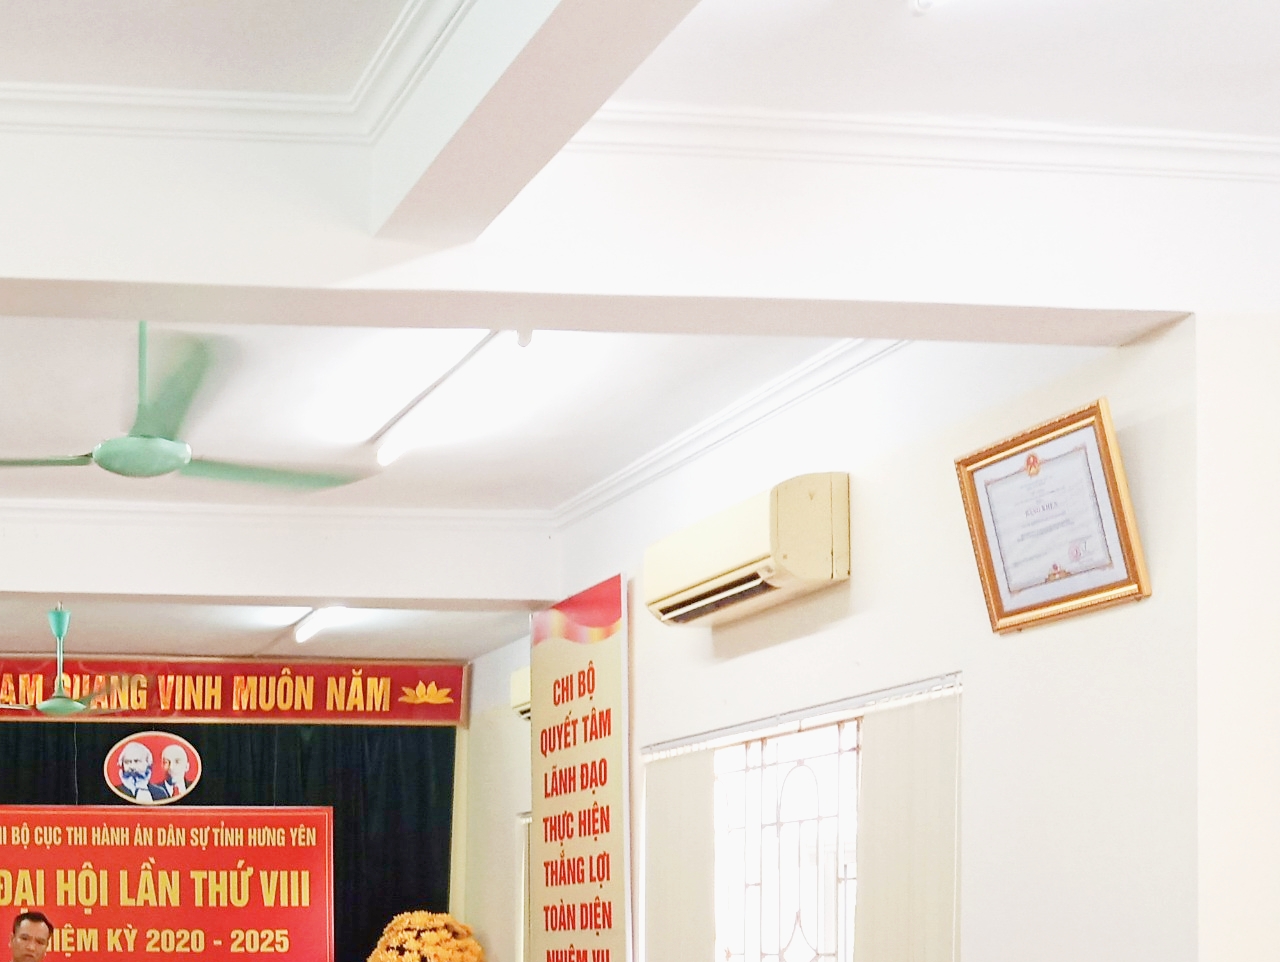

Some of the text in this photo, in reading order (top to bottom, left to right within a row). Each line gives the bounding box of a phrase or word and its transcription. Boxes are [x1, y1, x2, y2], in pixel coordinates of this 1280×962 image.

[157, 674, 221, 710] VINH
[232, 666, 314, 711] MUÔN
[326, 669, 391, 711] NĂM
[553, 660, 596, 707] CHI BỘ
[540, 707, 611, 758] QUYẾT TÂM
[544, 758, 607, 799] LÃNH ĐẠO
[11, 822, 30, 849] BỘ
[34, 827, 62, 850] CỤC
[66, 827, 88, 846] THI
[92, 822, 130, 846] HÀNH
[133, 823, 153, 846] ÁN
[157, 823, 186, 847] DÂN
[190, 825, 210, 850] SỰ
[212, 820, 244, 847] TỈNH
[247, 825, 286, 847] HƯNG
[290, 823, 316, 847] YÊN
[543, 801, 610, 846] THỰC HIỆN
[56, 861, 108, 915] HỘI
[119, 857, 180, 907] LẦN
[190, 859, 254, 907] THỨ
[259, 870, 310, 907] VIII
[543, 850, 610, 889] THẮNG LỢI
[543, 896, 612, 936] TOÀN DIỆN
[46, 923, 99, 958] IỆM
[107, 923, 138, 953] KỲ
[146, 928, 205, 953] 2020
[230, 928, 290, 953] 2025
